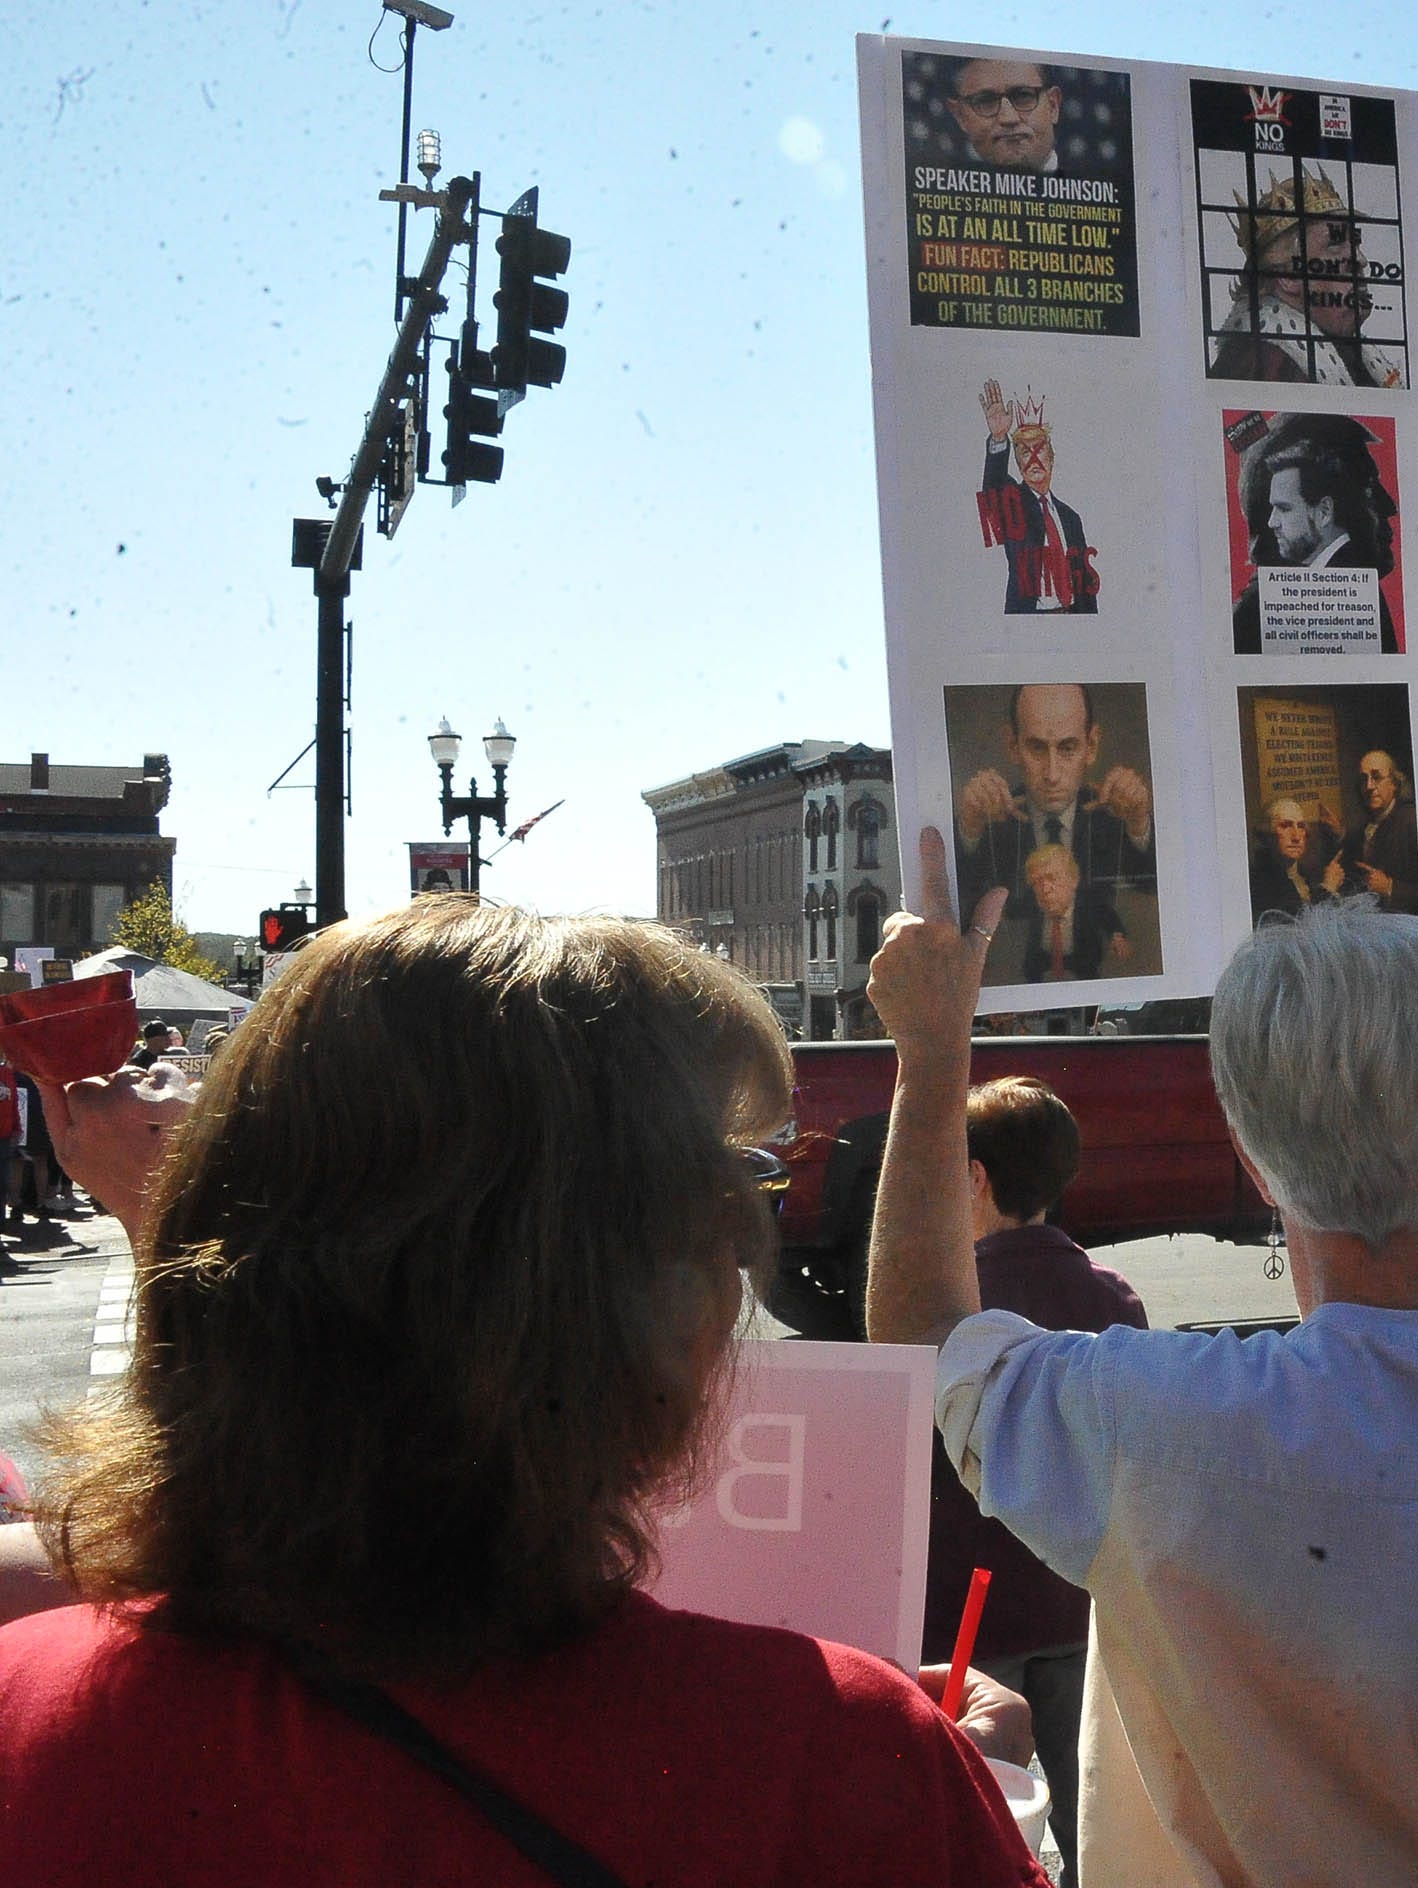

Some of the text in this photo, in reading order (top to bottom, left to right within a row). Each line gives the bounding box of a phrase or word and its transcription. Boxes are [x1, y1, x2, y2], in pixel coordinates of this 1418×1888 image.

[1255, 122, 1284, 142] NO
[1255, 140, 1285, 152] KINGS
[915, 167, 1119, 203] SPEAKER MIKE JOHNSON:
[975, 198, 1007, 215] FAITH
[1010, 200, 1022, 216] IN
[1024, 202, 1045, 218] THE
[1048, 203, 1123, 223] GOVERNMENT
[916, 213, 1120, 249] IS AT AN ALL TIME LOW."
[924, 243, 1115, 276] FUN FACT: REPUBLICANS
[1369, 261, 1400, 279] DO
[917, 271, 1124, 304] CONTROL ALL 3 BRANCHES
[938, 301, 1107, 330] OF THE GOVERNMENT.
[976, 484, 1027, 547] NO
[1268, 572, 1301, 583] Article
[1312, 572, 1349, 583] Section
[1351, 573, 1361, 584] 4:
[1362, 573, 1369, 583] If
[1282, 587, 1357, 600] the president is
[1264, 601, 1376, 613] impeached for treason,
[1267, 616, 1374, 627] the vice president and
[1265, 631, 1378, 640] all civil officers shall be
[1300, 645, 1346, 655] removed.
